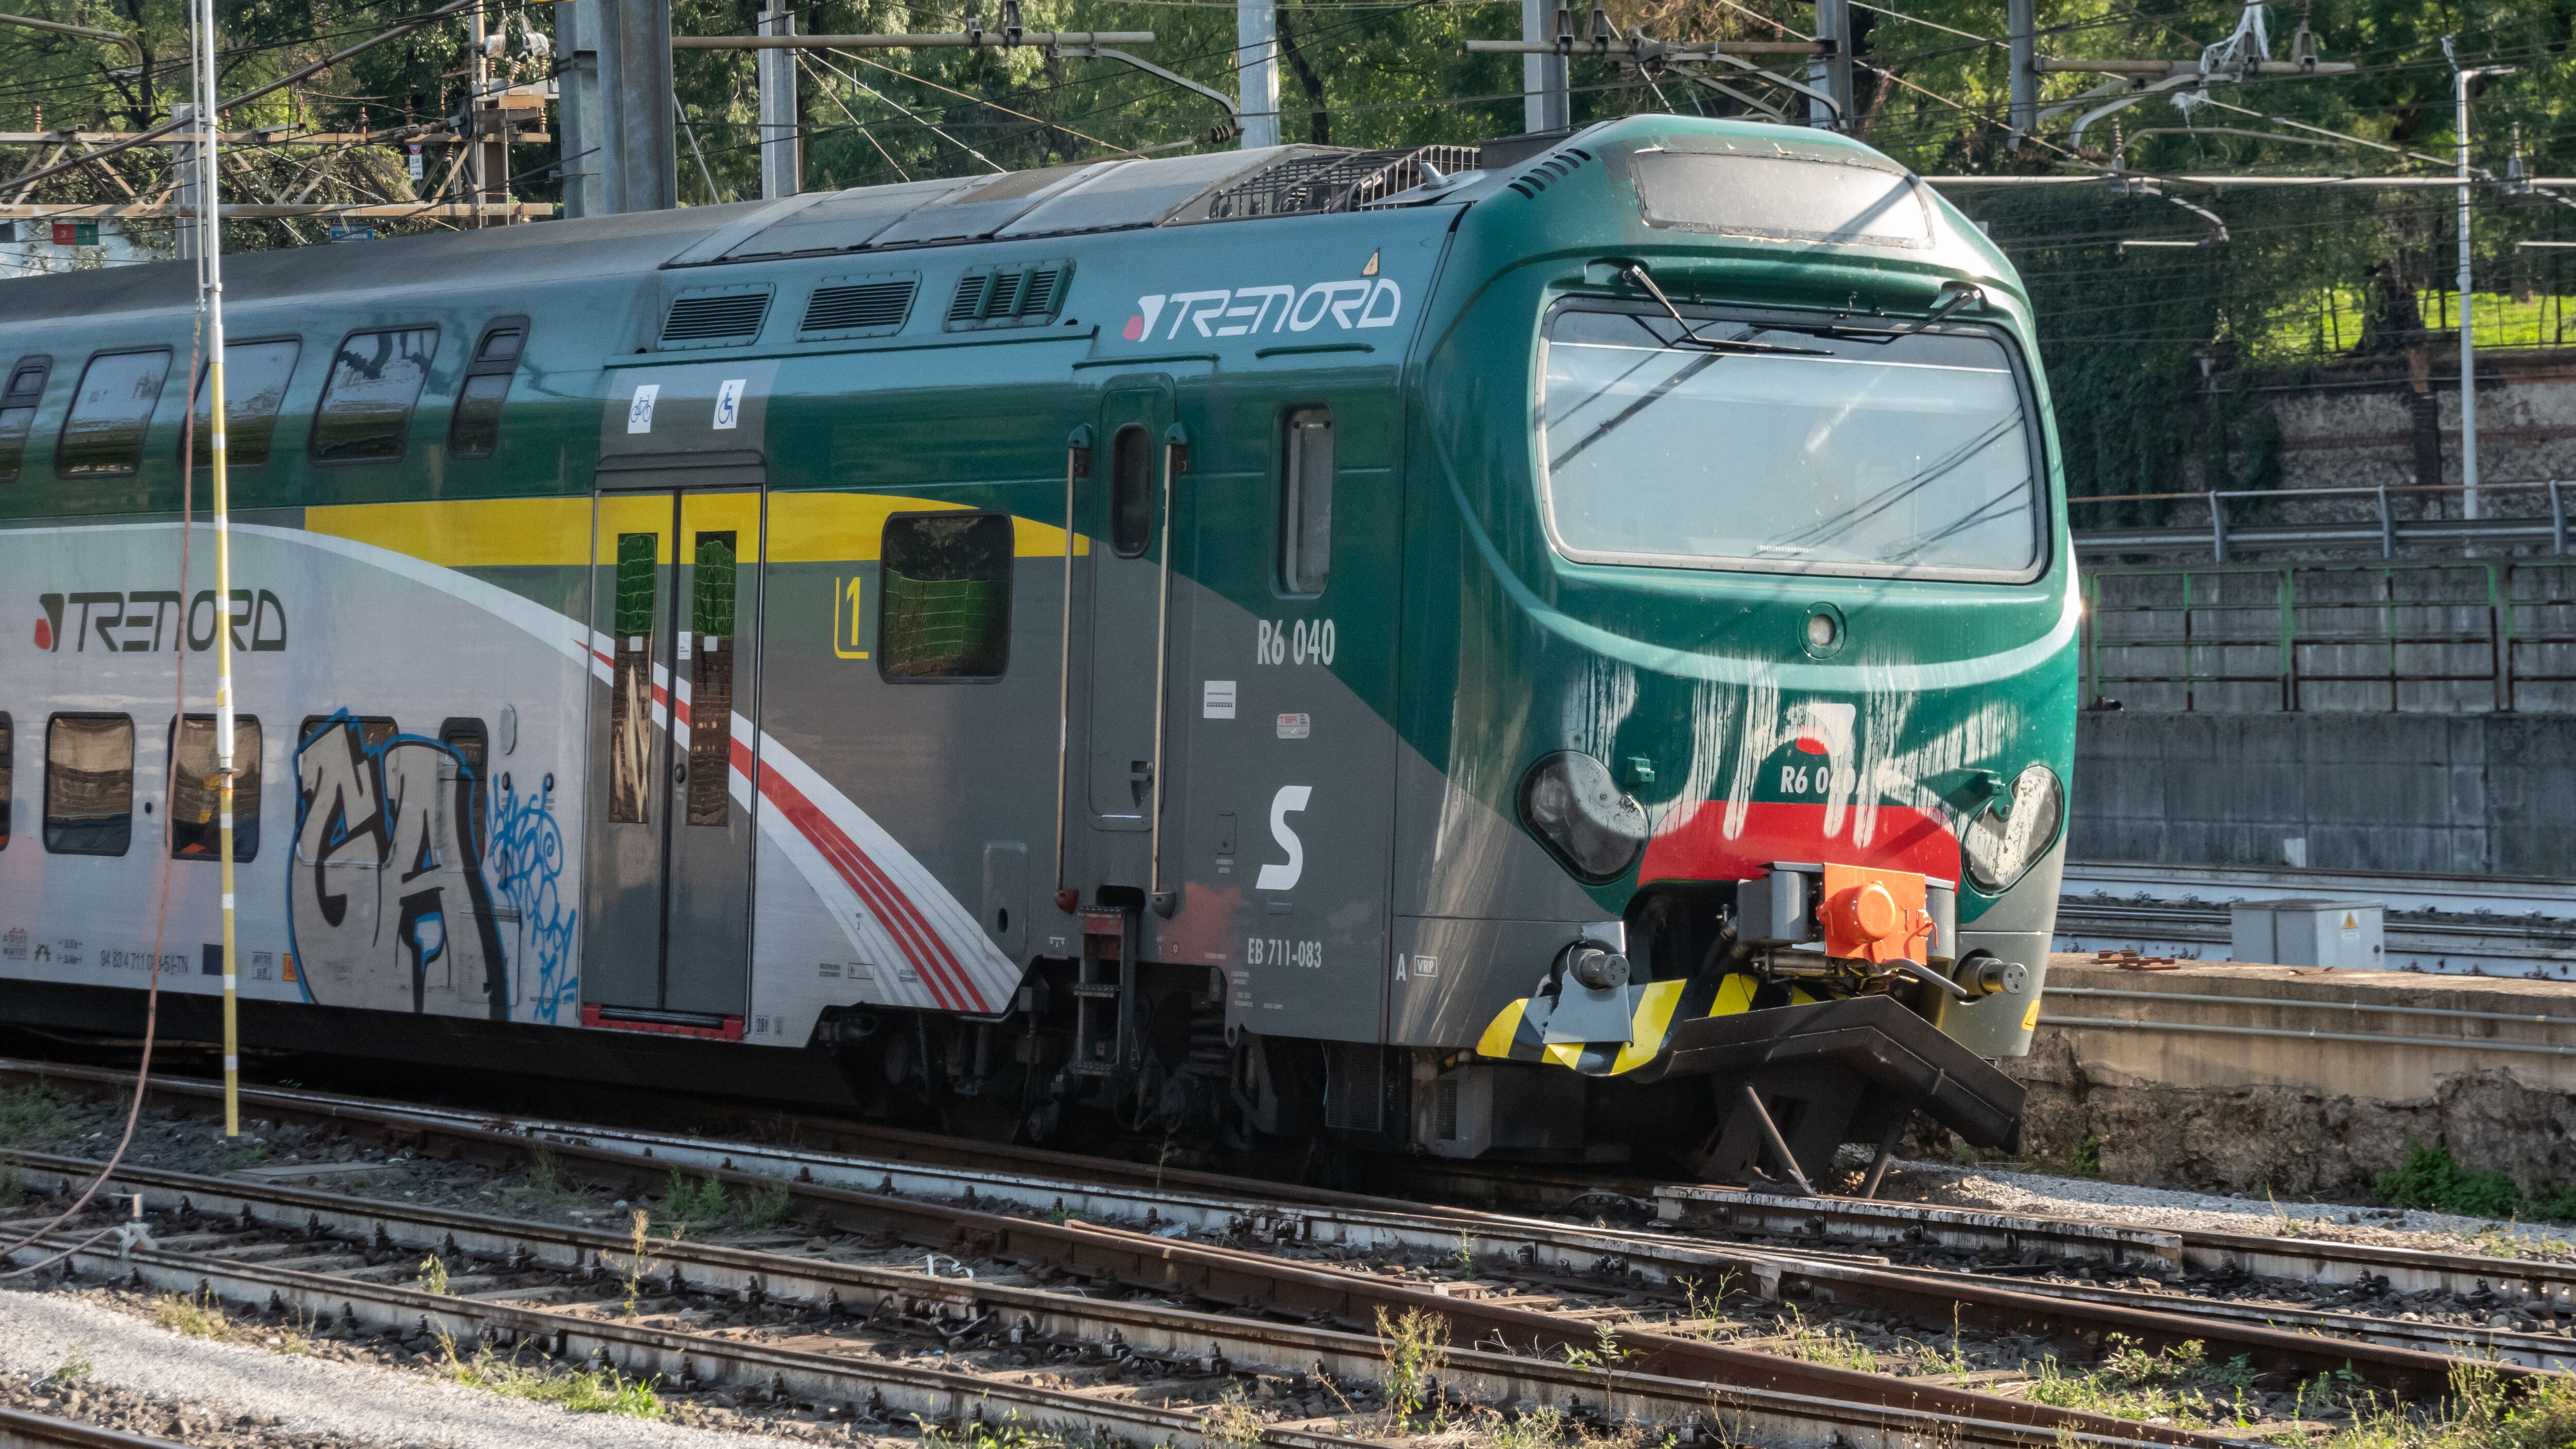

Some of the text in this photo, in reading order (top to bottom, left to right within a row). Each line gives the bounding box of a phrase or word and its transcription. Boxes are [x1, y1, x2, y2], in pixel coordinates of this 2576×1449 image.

[1167, 278, 1401, 340] TRENORD
[68, 589, 287, 653] TRENORD
[1257, 619, 1335, 665] R6 040
[1780, 765, 1808, 794] R6
[1255, 785, 1312, 890] S
[100, 950, 110, 967] 94
[112, 951, 122, 968] 83
[130, 953, 145, 970] 711
[1247, 938, 1322, 968] EB 711-083
[1395, 953, 1434, 981] A VRP
